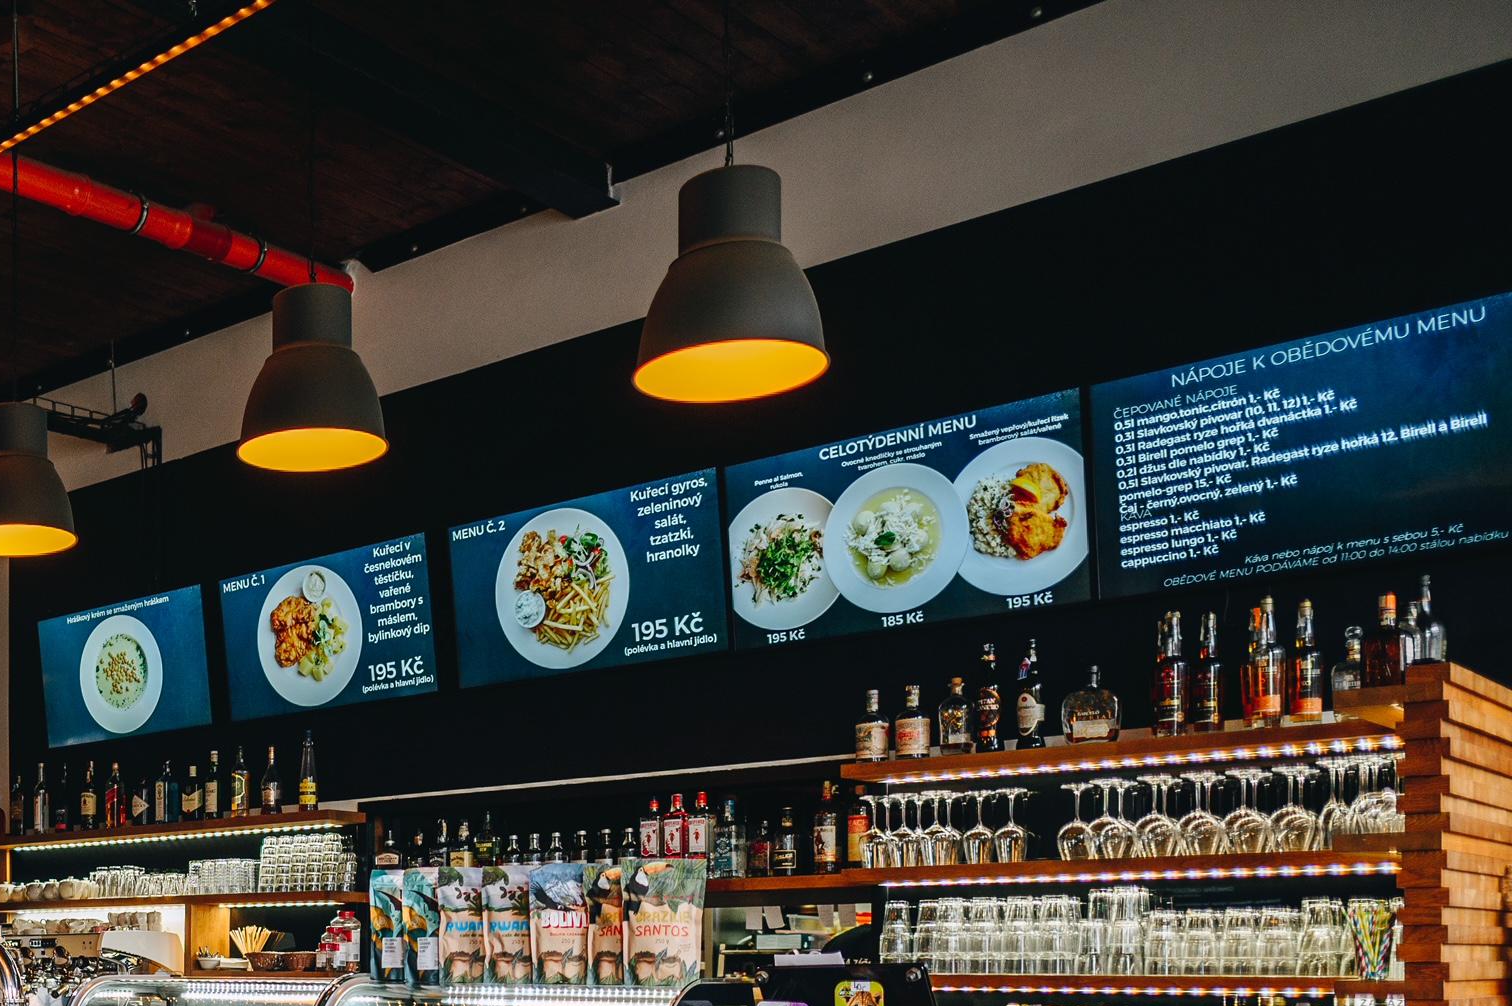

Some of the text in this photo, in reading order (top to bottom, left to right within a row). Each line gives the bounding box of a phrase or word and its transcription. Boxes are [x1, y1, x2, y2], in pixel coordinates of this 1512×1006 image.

[1171, 307, 1486, 388] NÁPOJE K OBĚDOVÉMU MENU
[1113, 385, 1238, 419] ČEPOVANÉ NÁPOJE
[1264, 387, 1280, 401] Kč
[1137, 415, 1198, 438] Slavkovský
[1200, 409, 1242, 427] pivovar
[818, 415, 977, 461] CELOTÝDENNÍ MENU
[1137, 430, 1192, 450] Radegast
[1193, 427, 1218, 441] ryze
[1138, 447, 1167, 463] Birell
[1170, 440, 1214, 459] pomelo
[1217, 435, 1245, 450] grep
[1262, 426, 1279, 439] Kč
[1139, 462, 1166, 475] džus
[1168, 457, 1187, 470] dle
[1253, 439, 1270, 453] Kč
[1140, 465, 1202, 487] Slavkovský
[1250, 446, 1310, 466] Radegast
[1311, 443, 1339, 457] ryze
[1438, 423, 1448, 432] a
[1216, 471, 1232, 485] Kč
[1281, 474, 1298, 487] Kč
[630, 483, 669, 502] Kuřecí
[637, 493, 702, 517] zeleninový
[452, 520, 506, 542] MENU Č. 2
[1119, 509, 1200, 533] espresso Kč
[1120, 510, 1266, 544] espresso macchiato Kč
[372, 540, 411, 558] Kuřecí v
[646, 544, 700, 563] hranolky
[1120, 528, 1237, 557] espresso lungo Kč
[1244, 553, 1269, 564] Káva
[1272, 547, 1300, 560] nebo
[1337, 539, 1344, 550] k
[1346, 536, 1380, 548] menu
[1383, 535, 1389, 543] s
[1392, 529, 1428, 542] sebou
[364, 552, 422, 574] česnekovém
[1121, 542, 1219, 568] cappuccino Kč
[1219, 565, 1252, 579] MENU
[1322, 553, 1338, 565] od
[1369, 547, 1385, 557] do
[223, 574, 265, 594] MENU Č. 1
[378, 582, 411, 599] vařené
[370, 595, 424, 615] brambory s
[1006, 593, 1054, 609] 195 Kč
[632, 612, 704, 642] 195 Kč
[881, 611, 924, 628] 185 Kč
[368, 622, 430, 645] bylinkový dip
[766, 628, 806, 644] 195 Kč
[624, 643, 659, 657] (polévka
[667, 636, 693, 649] hlavní
[368, 656, 424, 682] 195 Kč
[635, 924, 689, 937] SANTOS
